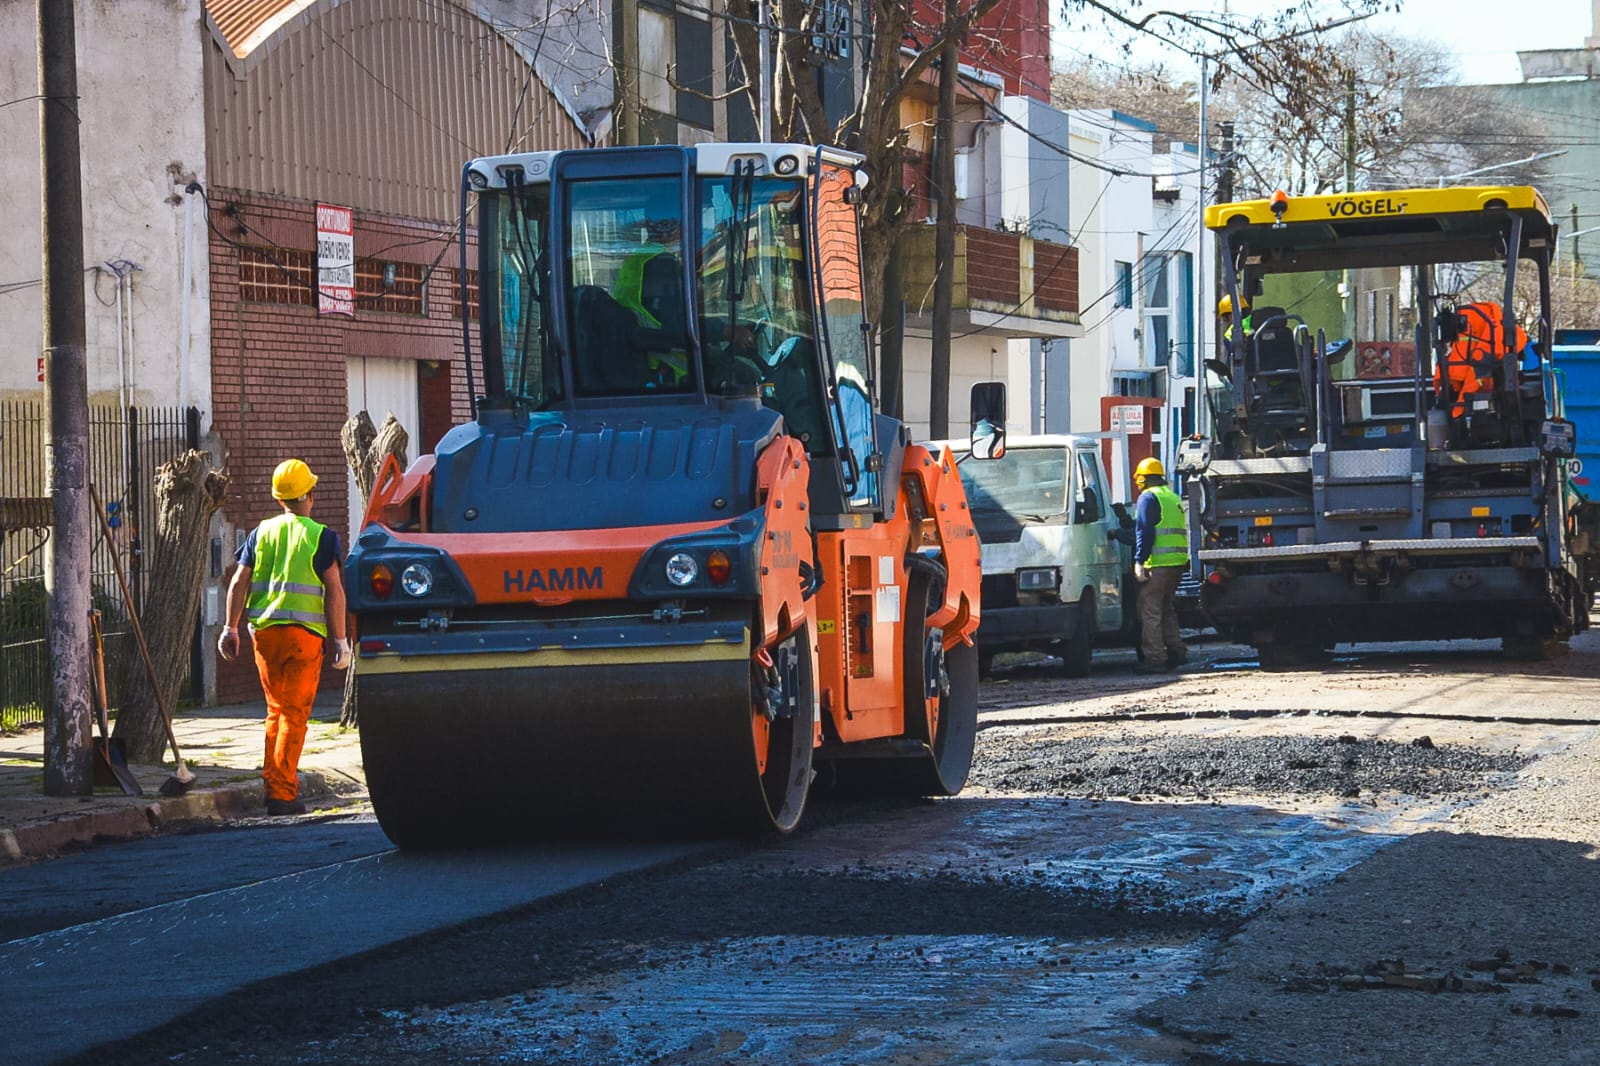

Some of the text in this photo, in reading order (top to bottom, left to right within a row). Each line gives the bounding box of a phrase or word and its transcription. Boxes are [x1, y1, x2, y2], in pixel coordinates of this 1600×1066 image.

[317, 207, 351, 232] OPORTUNIDAD
[318, 236, 350, 260] DUEÑO VENDE
[1112, 411, 1142, 420] ALUILA
[504, 567, 603, 592] HAMM
